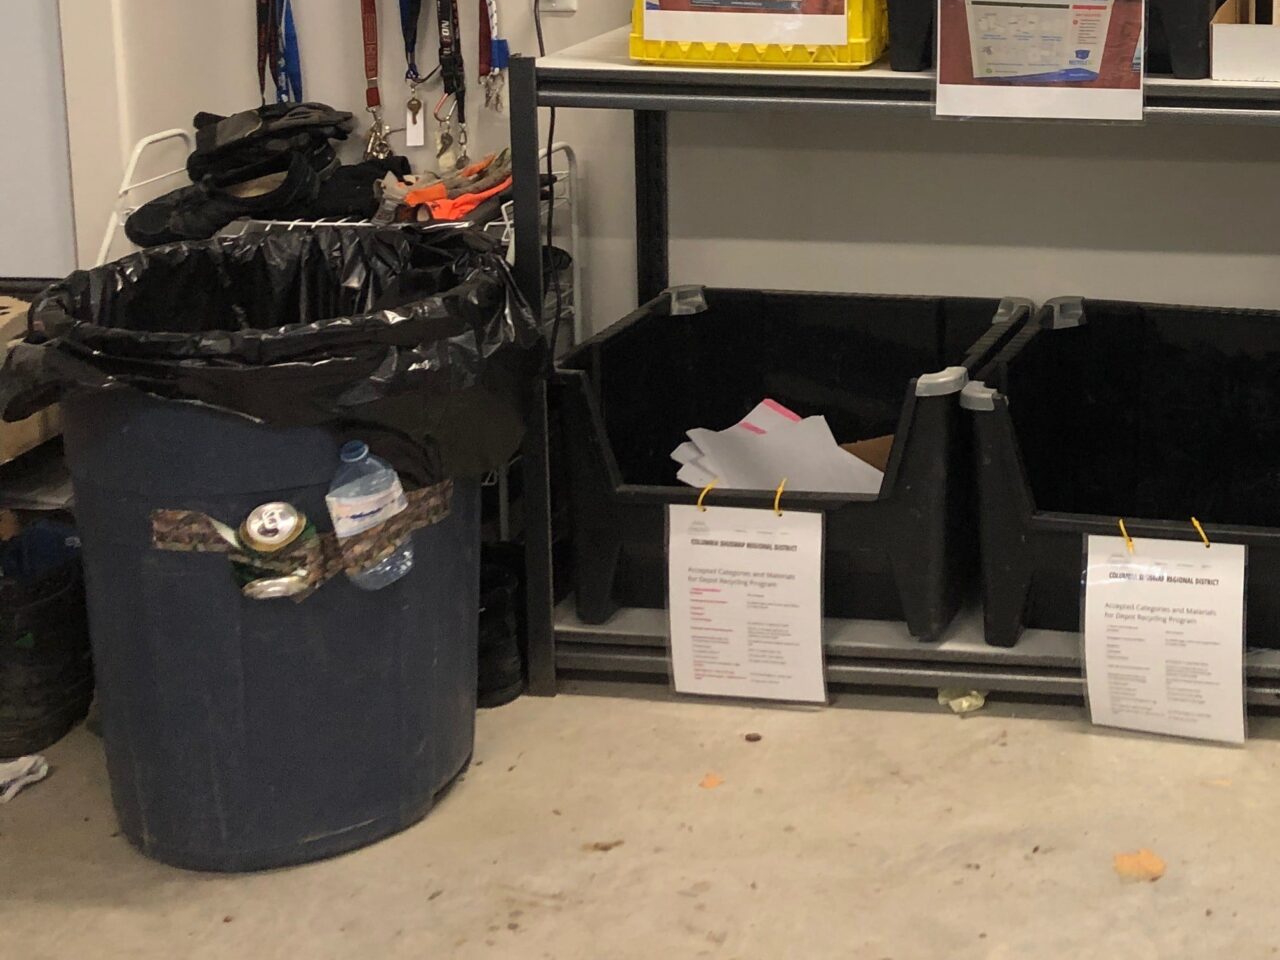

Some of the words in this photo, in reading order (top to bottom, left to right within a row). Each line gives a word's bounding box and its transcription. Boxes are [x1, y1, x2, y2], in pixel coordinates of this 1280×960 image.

[1195, 578, 1219, 586] DISTRICT
[1105, 602, 1135, 611] Accepted
[1136, 604, 1171, 613] Categories
[1186, 608, 1217, 616] Materials
[1115, 612, 1136, 620] Depot
[1137, 614, 1167, 624] Recycling
[1168, 616, 1197, 625] Program
